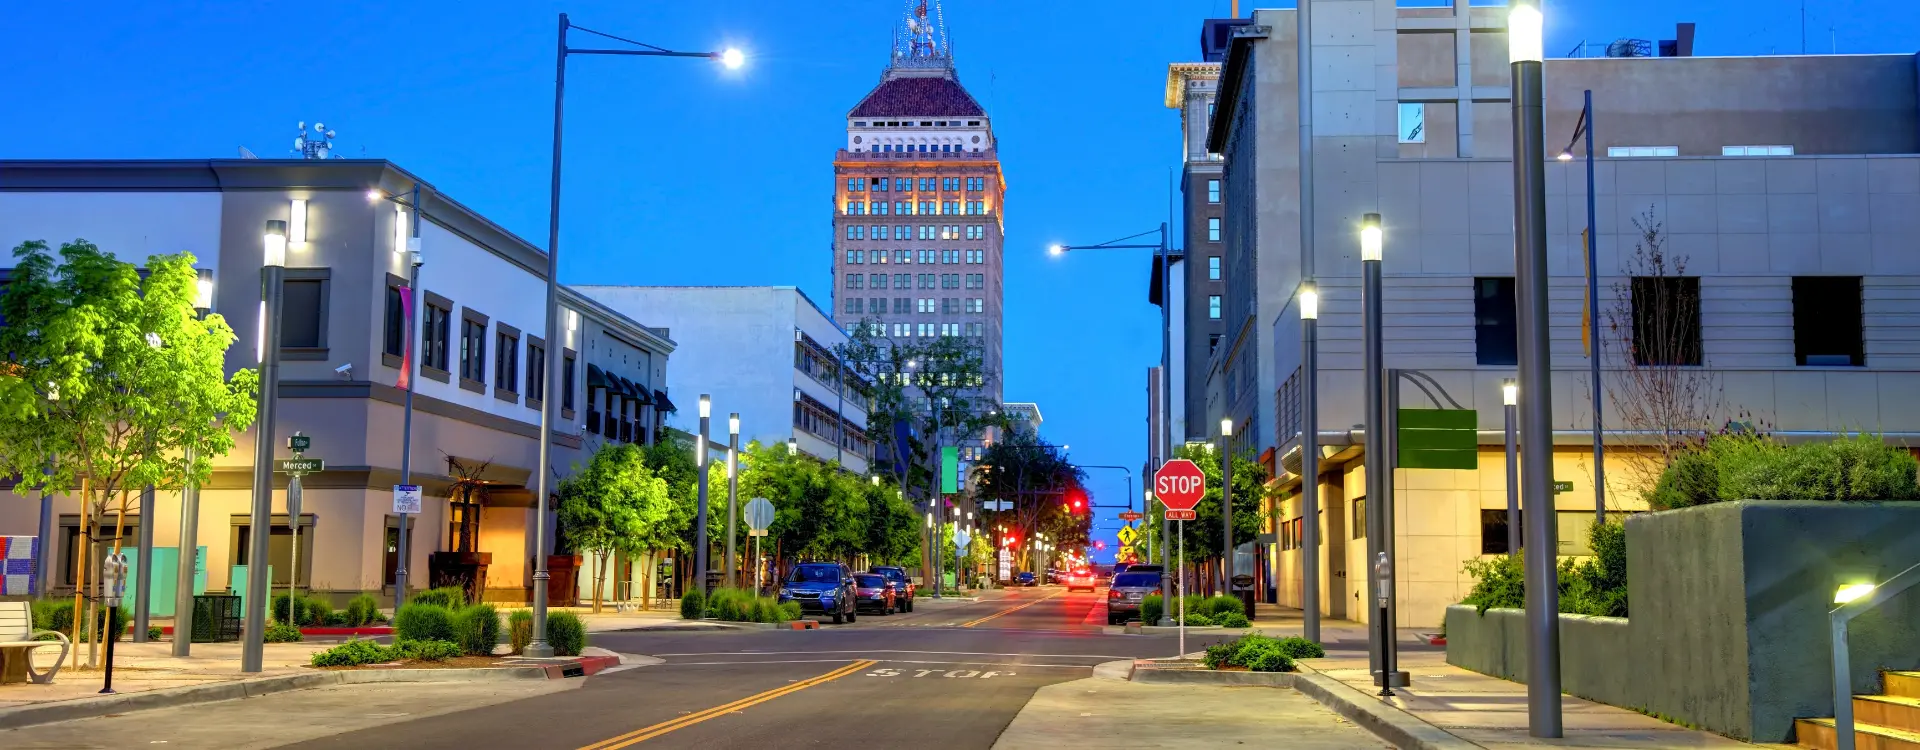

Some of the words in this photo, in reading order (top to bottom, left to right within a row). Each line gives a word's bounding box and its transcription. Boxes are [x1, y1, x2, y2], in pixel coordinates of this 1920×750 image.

[282, 461, 312, 470] Merced
[1158, 475, 1202, 494] STOP
[1168, 511, 1179, 519] ALL
[1181, 511, 1193, 519] WAY
[866, 668, 1017, 679] STOP
